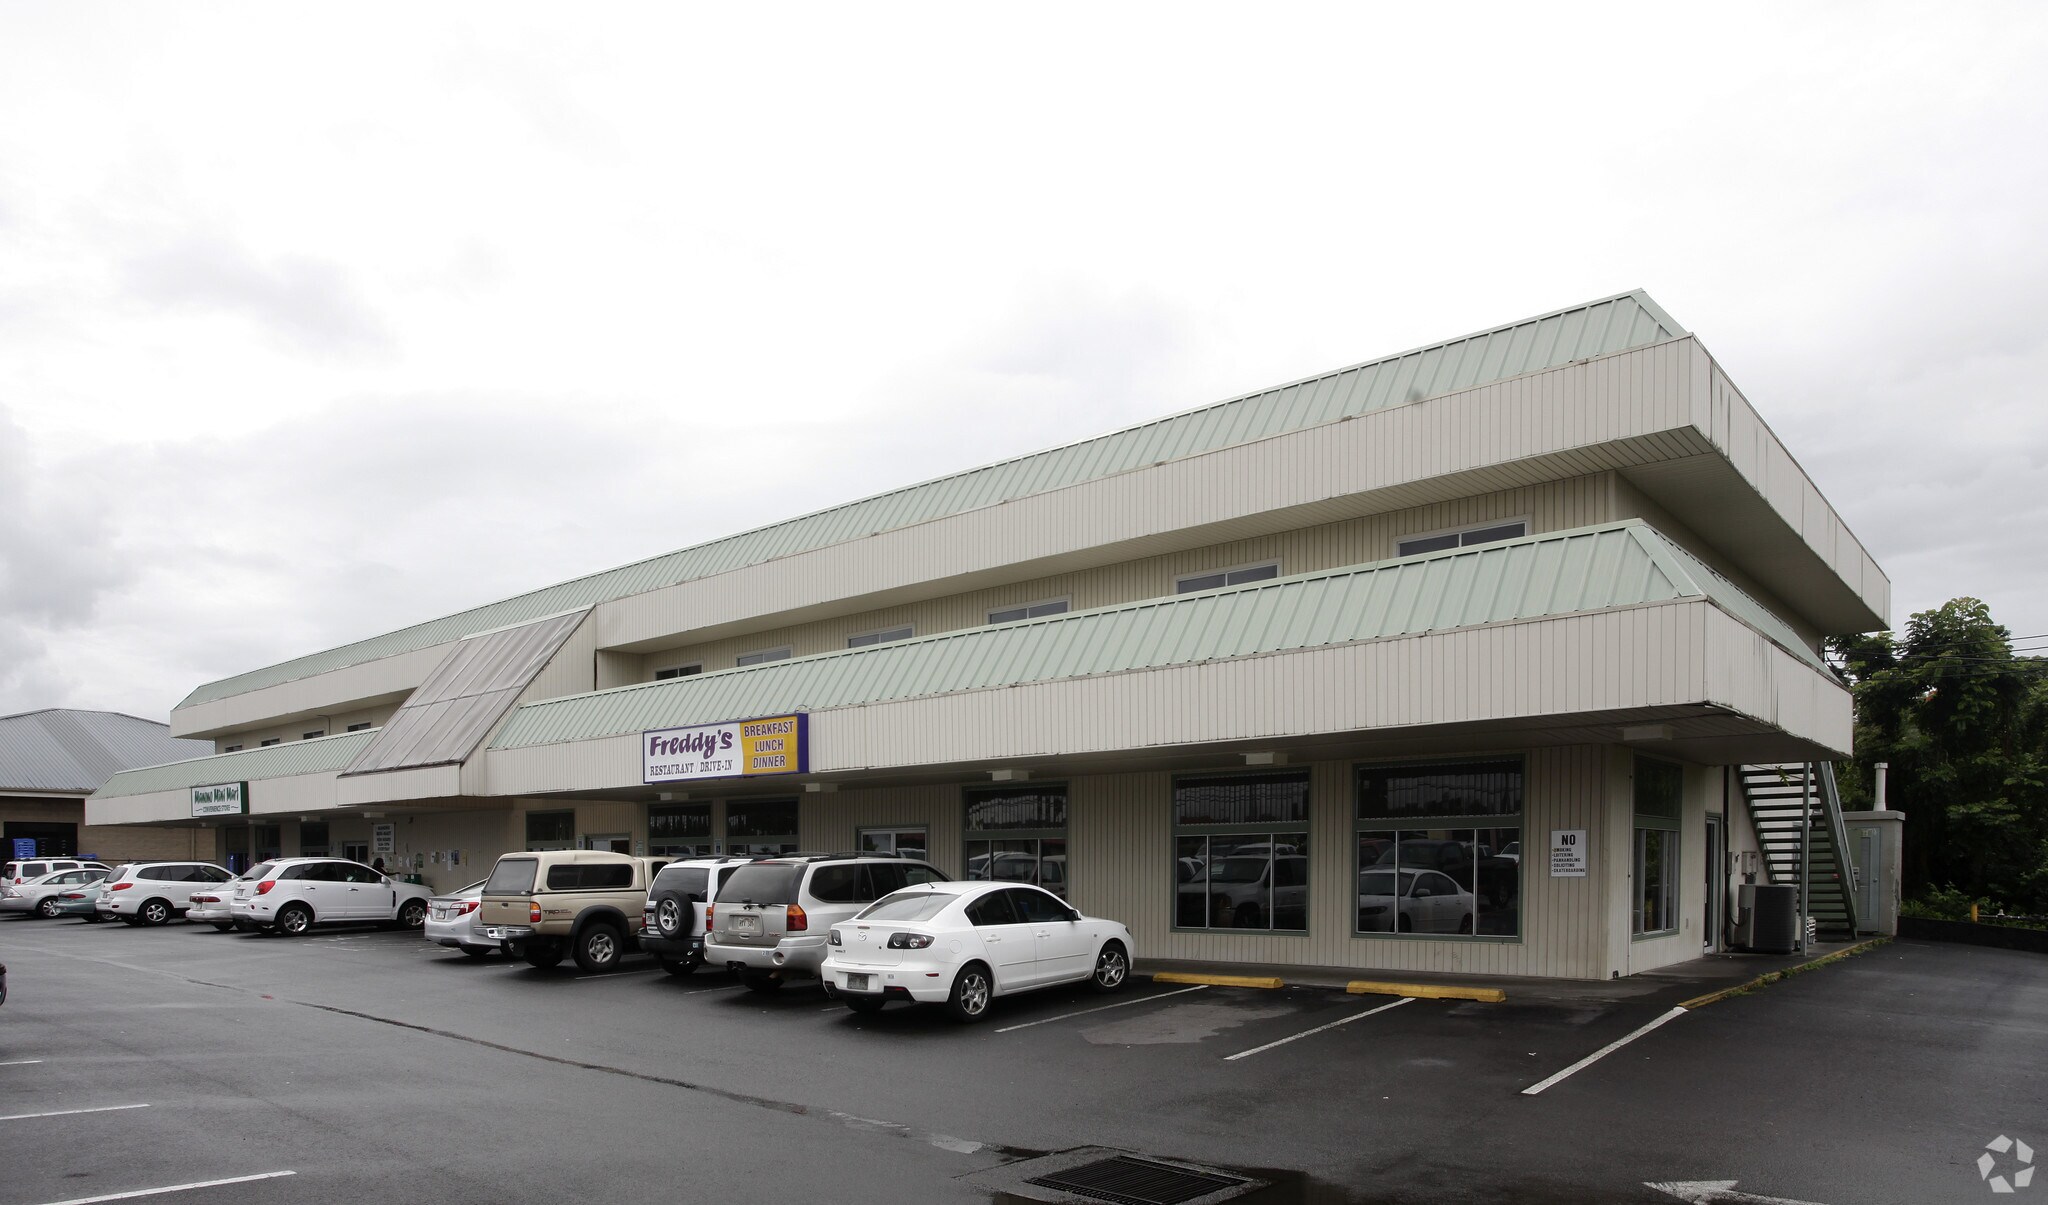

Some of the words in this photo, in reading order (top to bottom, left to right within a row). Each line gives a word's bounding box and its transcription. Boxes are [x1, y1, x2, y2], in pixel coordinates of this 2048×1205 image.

[744, 721, 794, 738] BREAKFAST
[650, 729, 733, 760] Freddy's
[754, 738, 784, 753] LUNCH
[650, 762, 695, 777] RESTAURANT
[700, 759, 733, 773] DRIVE-IN
[753, 755, 786, 769] DINNER
[1561, 834, 1576, 846] NO
